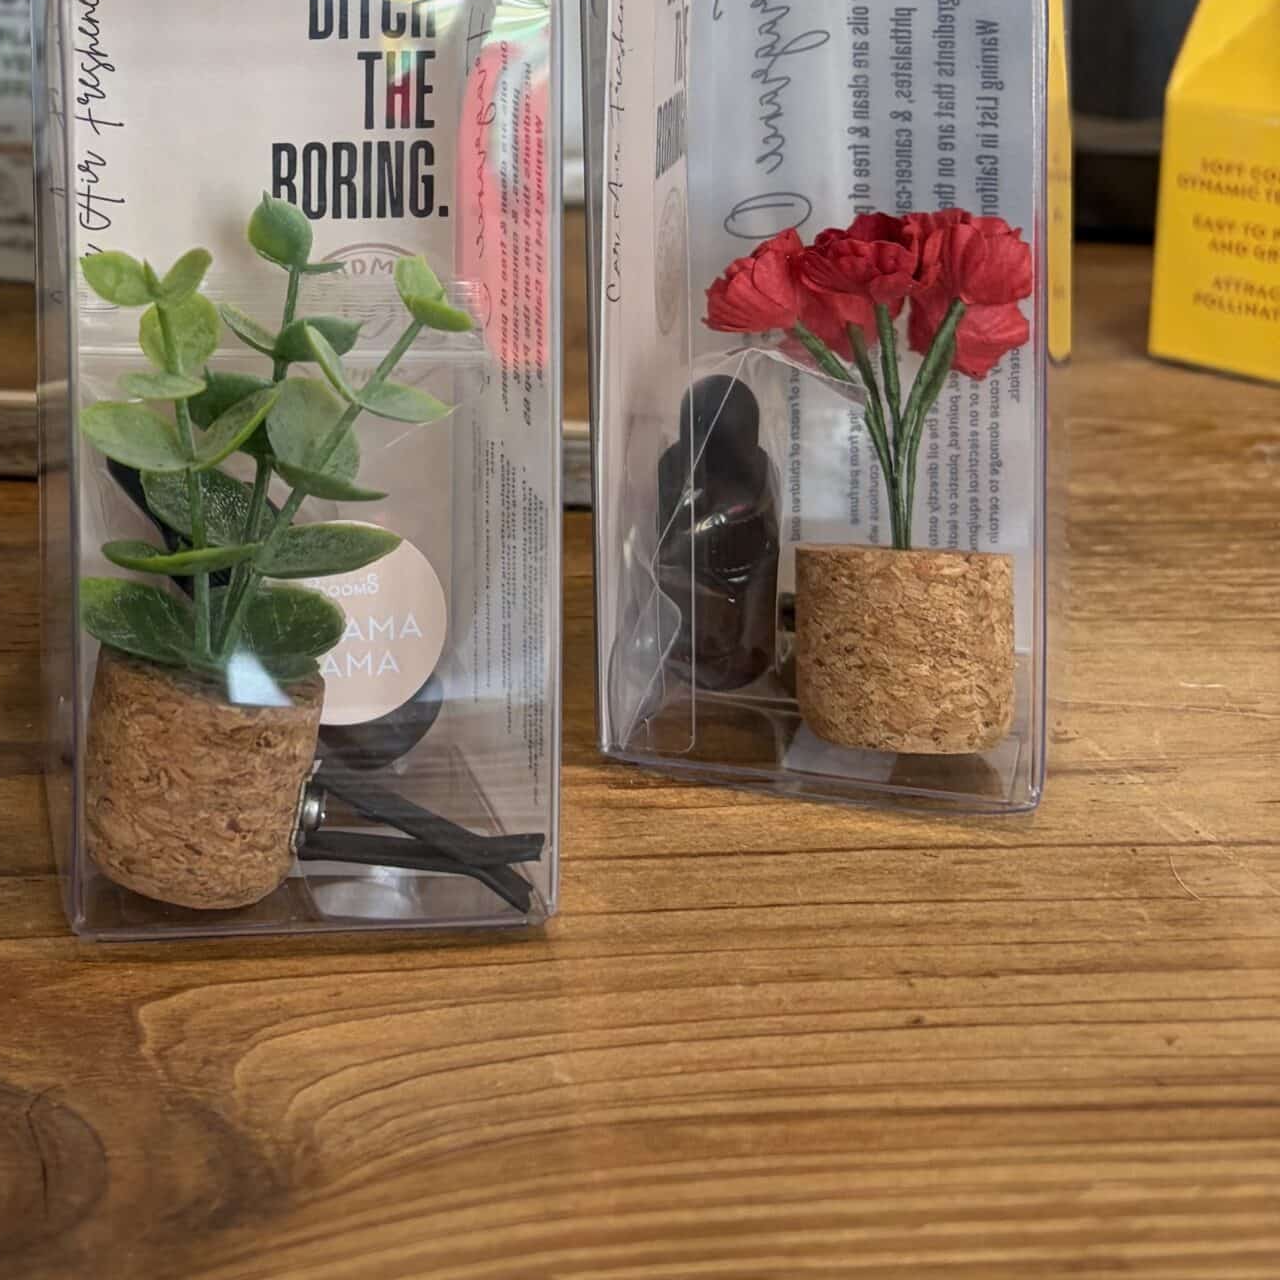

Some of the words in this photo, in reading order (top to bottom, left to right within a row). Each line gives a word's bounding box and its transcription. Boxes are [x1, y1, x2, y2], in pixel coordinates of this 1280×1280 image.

[357, 49, 437, 130] THE
[271, 139, 449, 220] BORING.
[322, 647, 402, 679] AMA
